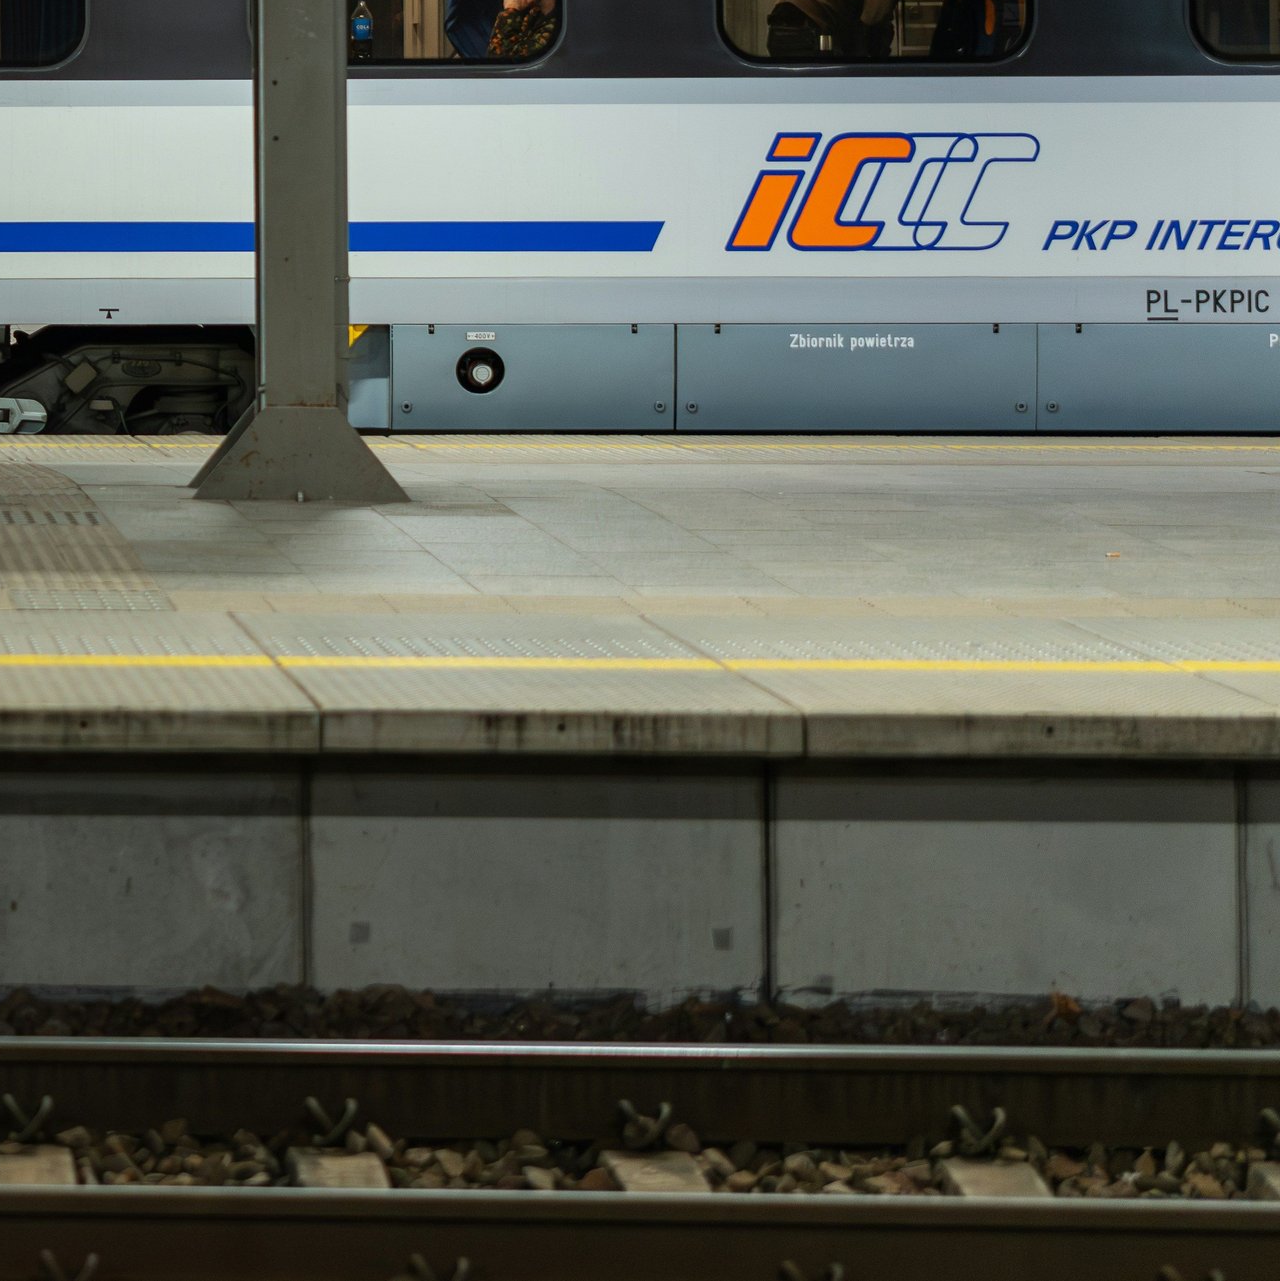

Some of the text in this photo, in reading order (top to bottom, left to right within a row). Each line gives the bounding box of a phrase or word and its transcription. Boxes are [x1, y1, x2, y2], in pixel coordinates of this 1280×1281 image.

[1042, 219, 1280, 251] PKP INTER
[1146, 289, 1269, 313] PL-PKPIC
[789, 333, 915, 352] Zbiornik powietrza
